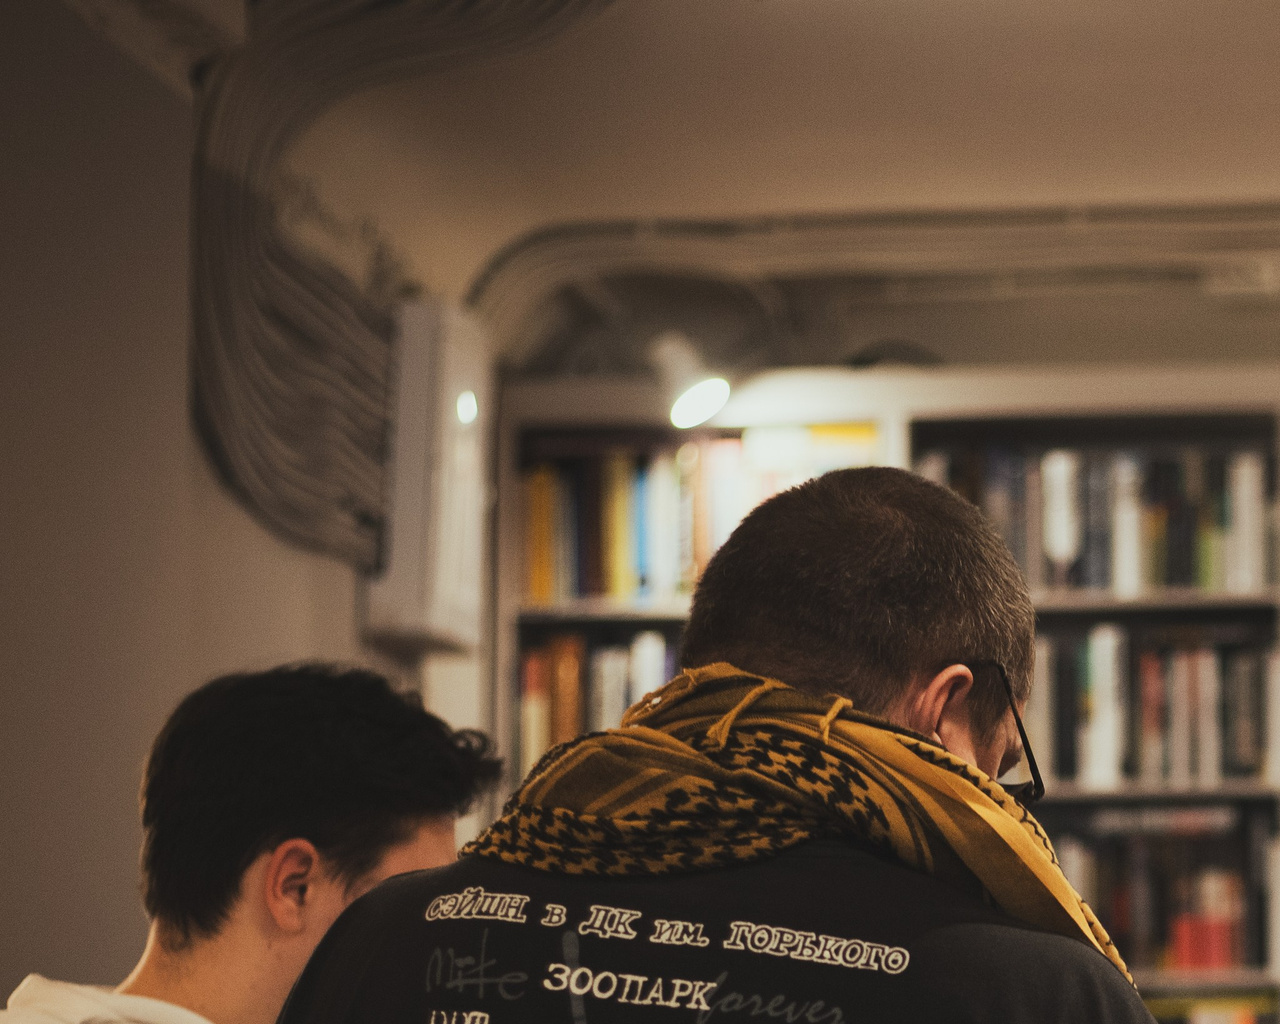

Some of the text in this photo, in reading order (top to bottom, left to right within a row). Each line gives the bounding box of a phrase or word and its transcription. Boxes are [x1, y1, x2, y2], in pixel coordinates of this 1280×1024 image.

[578, 905, 642, 939] ДК
[649, 919, 710, 947] им.
[723, 921, 910, 974] ГОРЬКОГО
[543, 963, 717, 1011] ЗООПАРК
